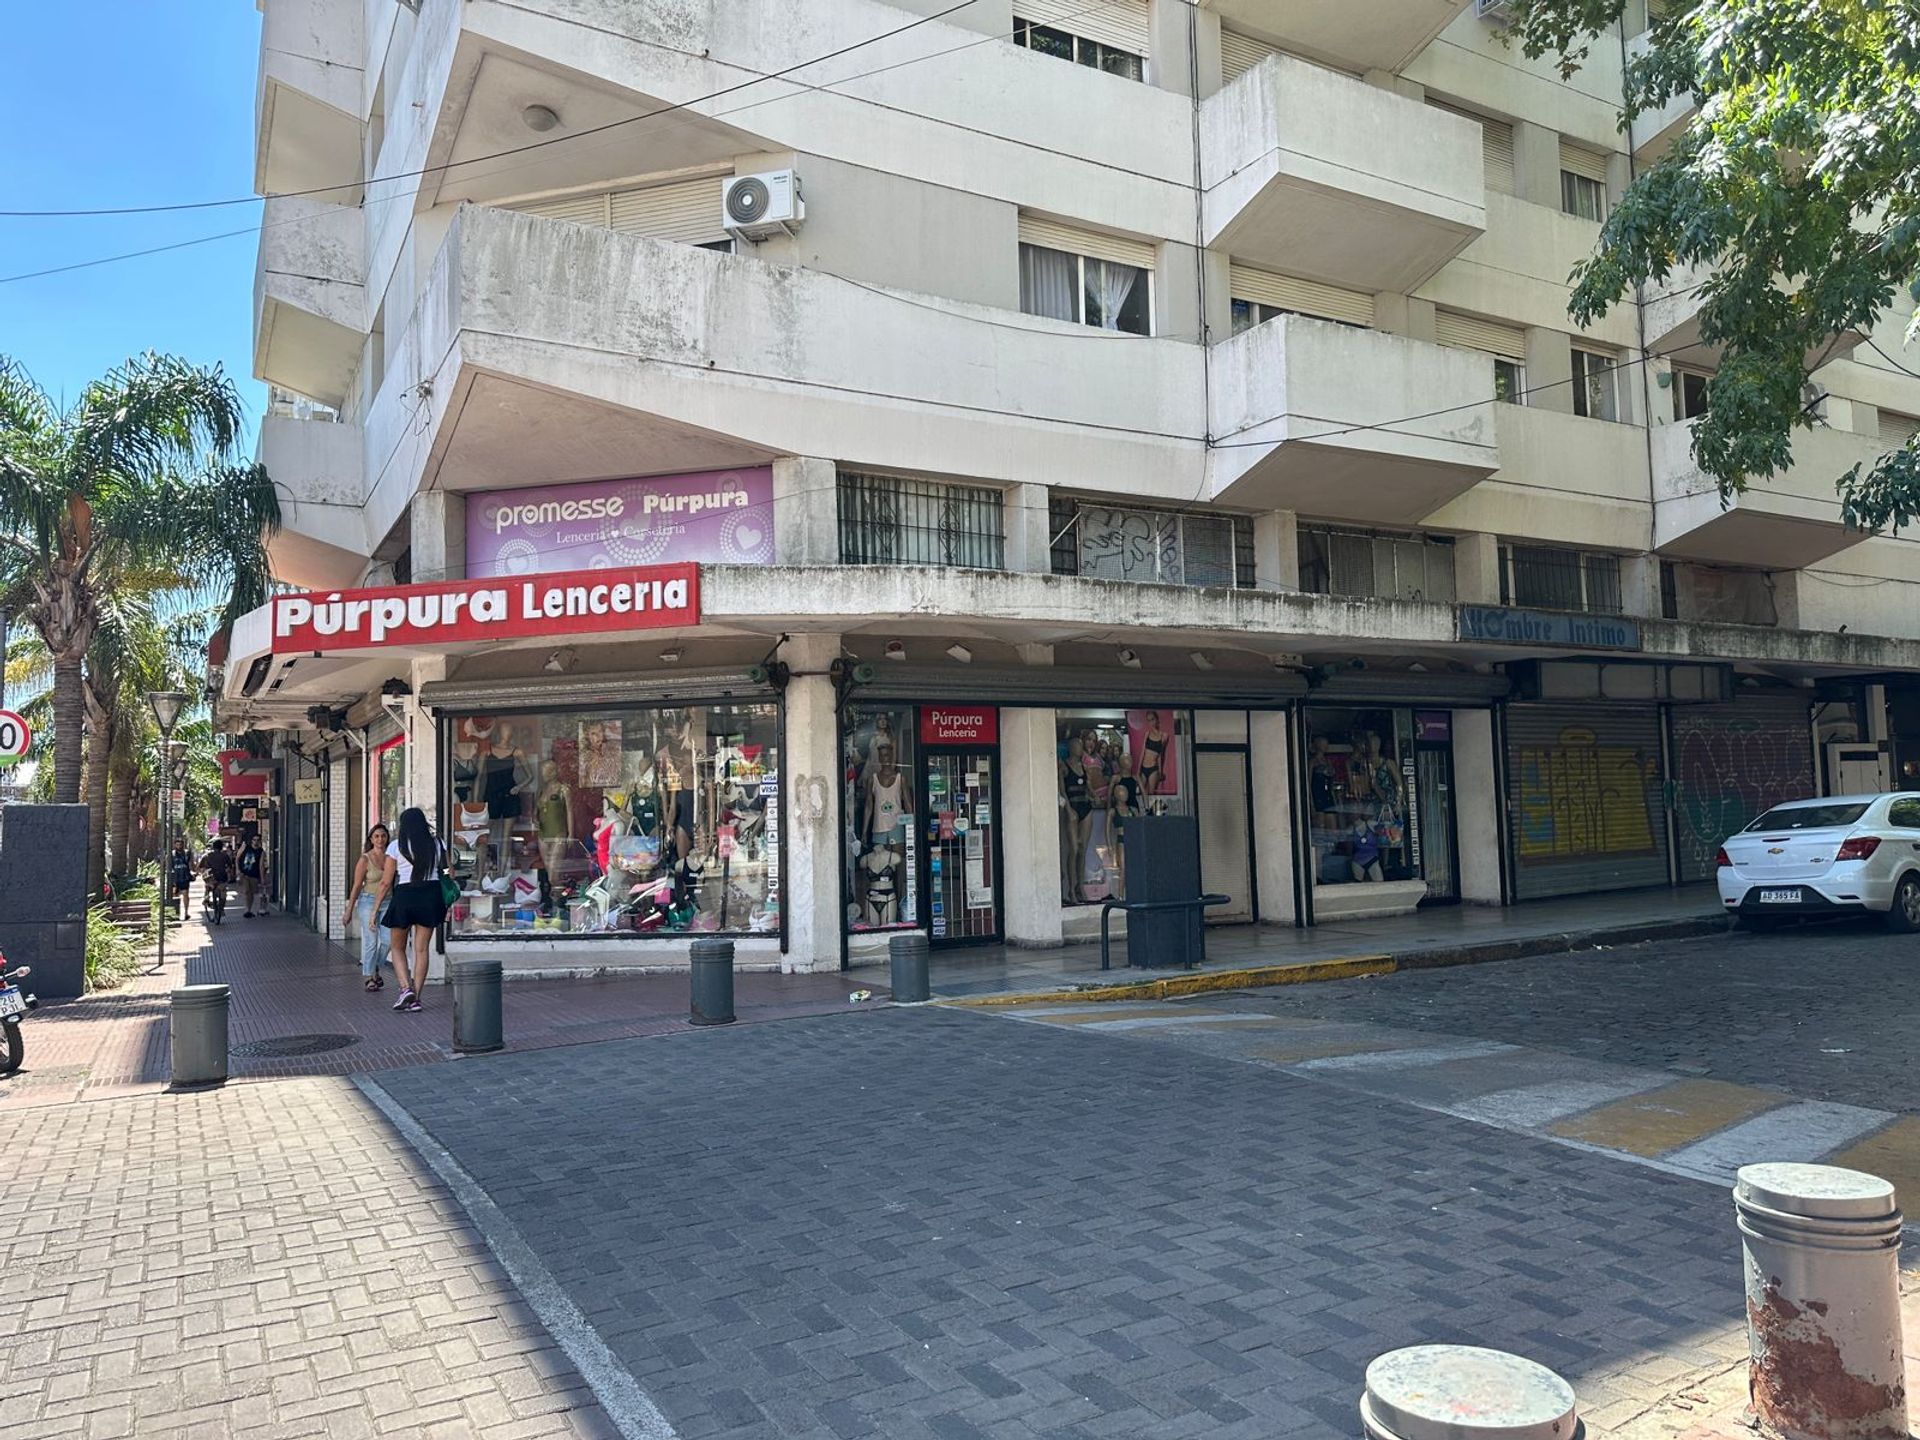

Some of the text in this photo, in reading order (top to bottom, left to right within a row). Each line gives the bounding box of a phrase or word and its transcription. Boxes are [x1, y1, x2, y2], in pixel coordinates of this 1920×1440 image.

[496, 490, 749, 534] promesse Púrpura
[275, 588, 508, 642] Púrpura
[931, 711, 983, 730] Púrpura
[761, 785, 778, 793] VISA
